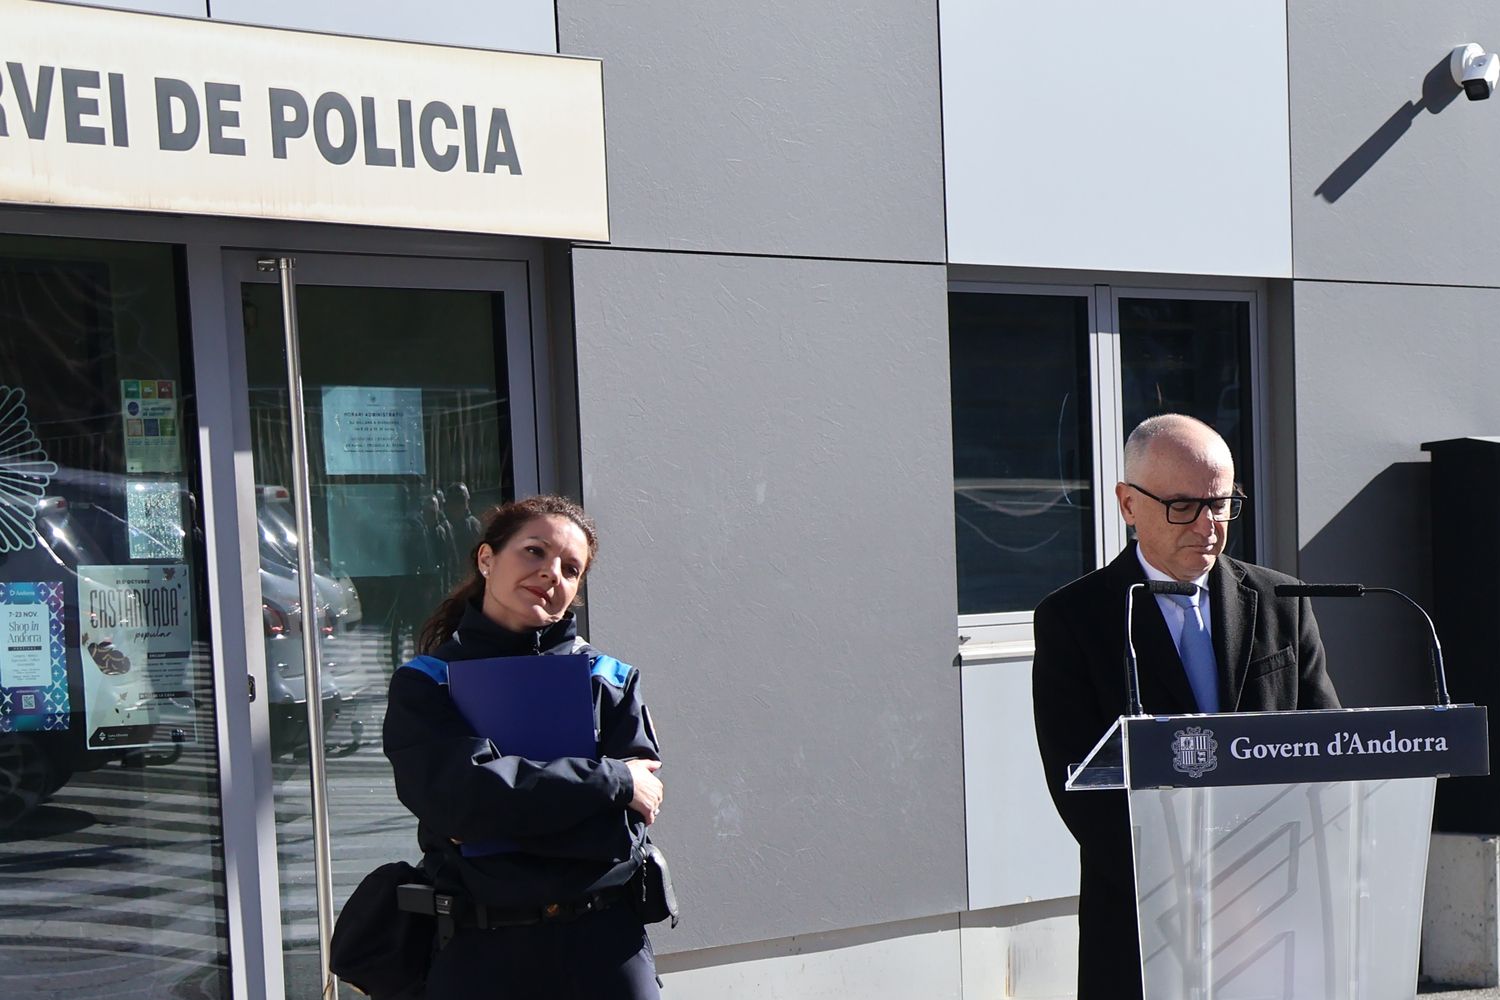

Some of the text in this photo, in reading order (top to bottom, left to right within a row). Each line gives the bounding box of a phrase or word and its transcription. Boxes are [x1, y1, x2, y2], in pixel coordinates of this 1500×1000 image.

[0, 62, 523, 177] VEI DE POLICIA
[90, 587, 179, 629] CASTANYADA
[8, 621, 39, 635] Shop in
[8, 632, 42, 643] Andorra
[134, 627, 172, 643] popular
[1230, 730, 1449, 761] Govern d'Andorra
